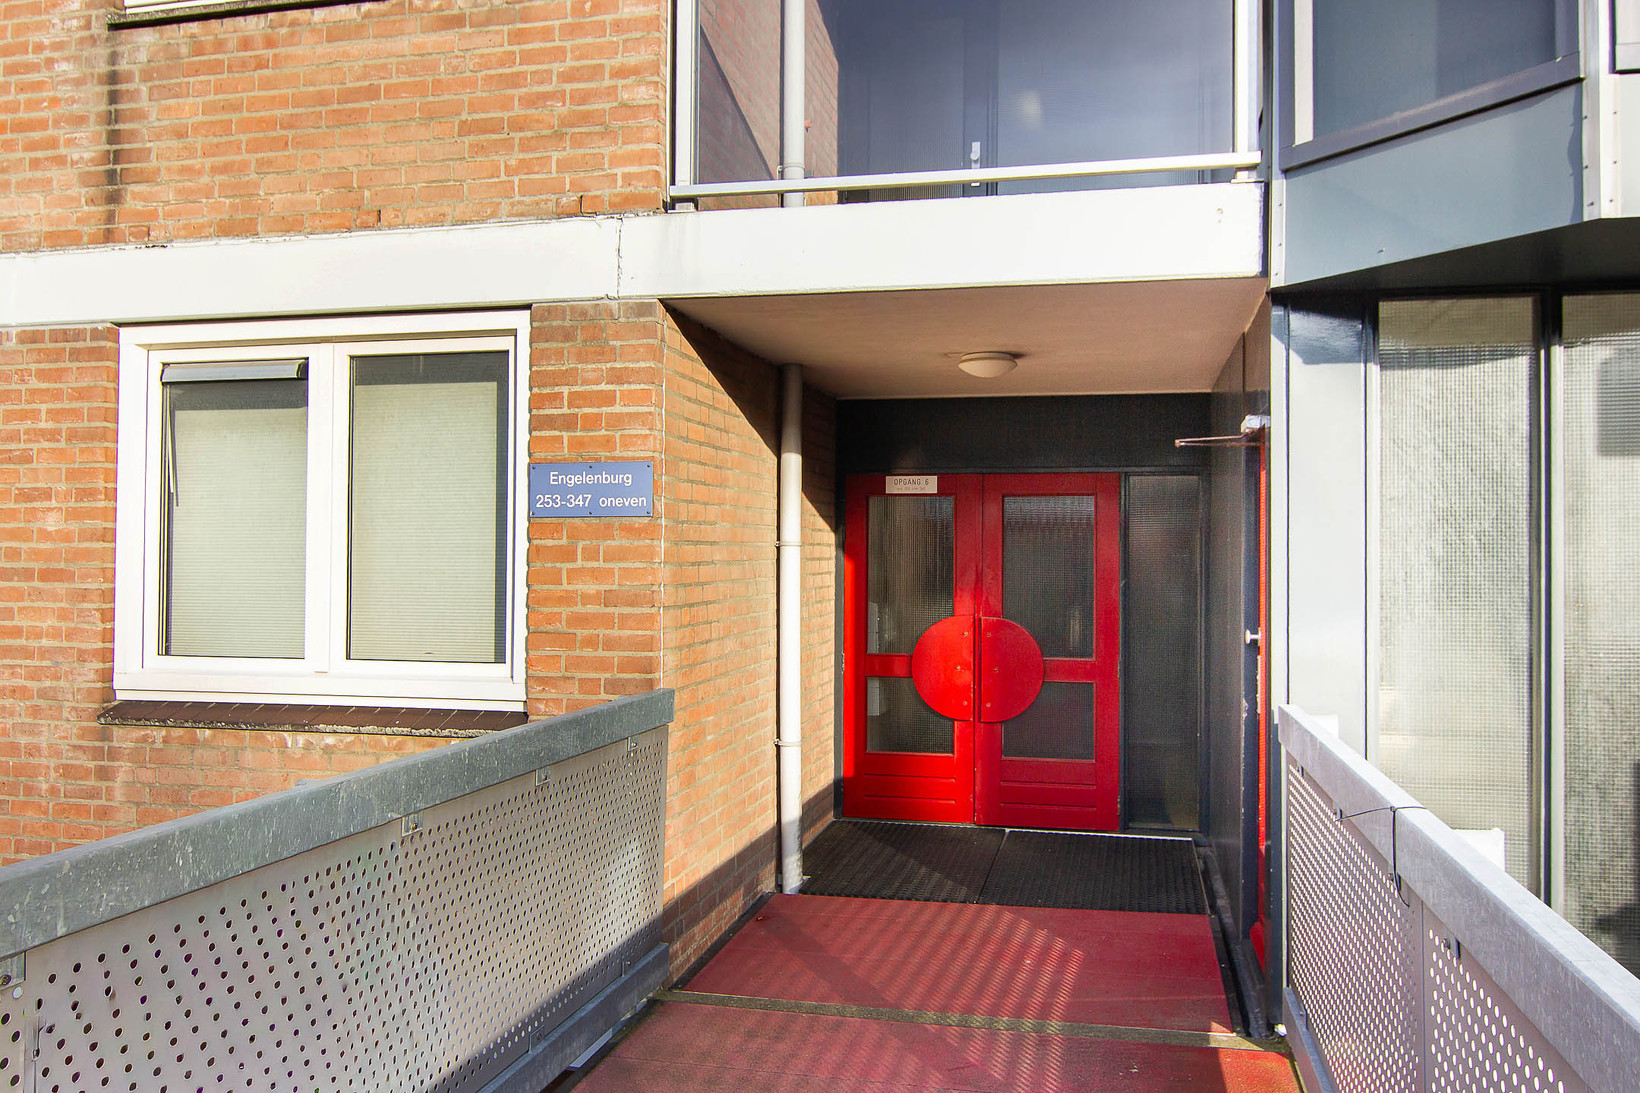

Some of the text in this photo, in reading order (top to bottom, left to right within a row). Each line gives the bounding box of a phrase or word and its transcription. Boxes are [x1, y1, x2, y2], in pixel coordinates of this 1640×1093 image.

[550, 471, 632, 486] Engelenburg
[536, 494, 647, 508] 253-347 oneven
